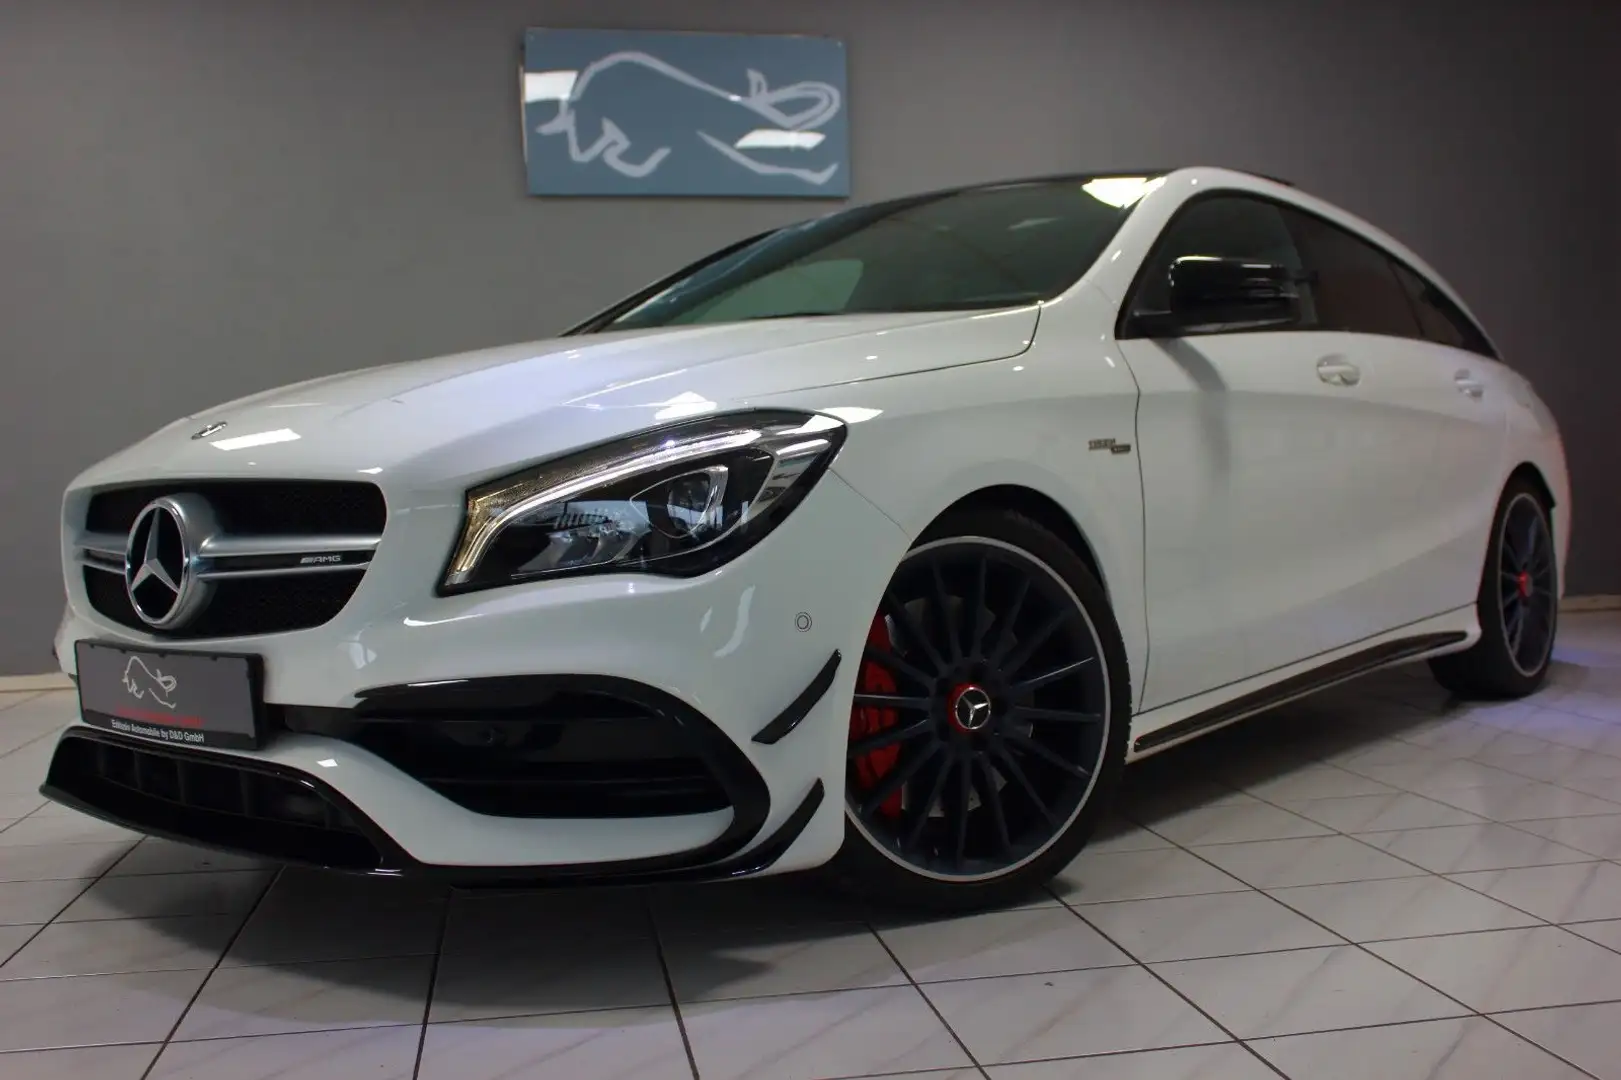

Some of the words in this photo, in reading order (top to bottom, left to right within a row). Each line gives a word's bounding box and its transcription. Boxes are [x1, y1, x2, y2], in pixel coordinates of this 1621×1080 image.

[160, 729, 169, 741] by
[169, 729, 184, 740] D&D
[184, 731, 205, 743] GmbH
